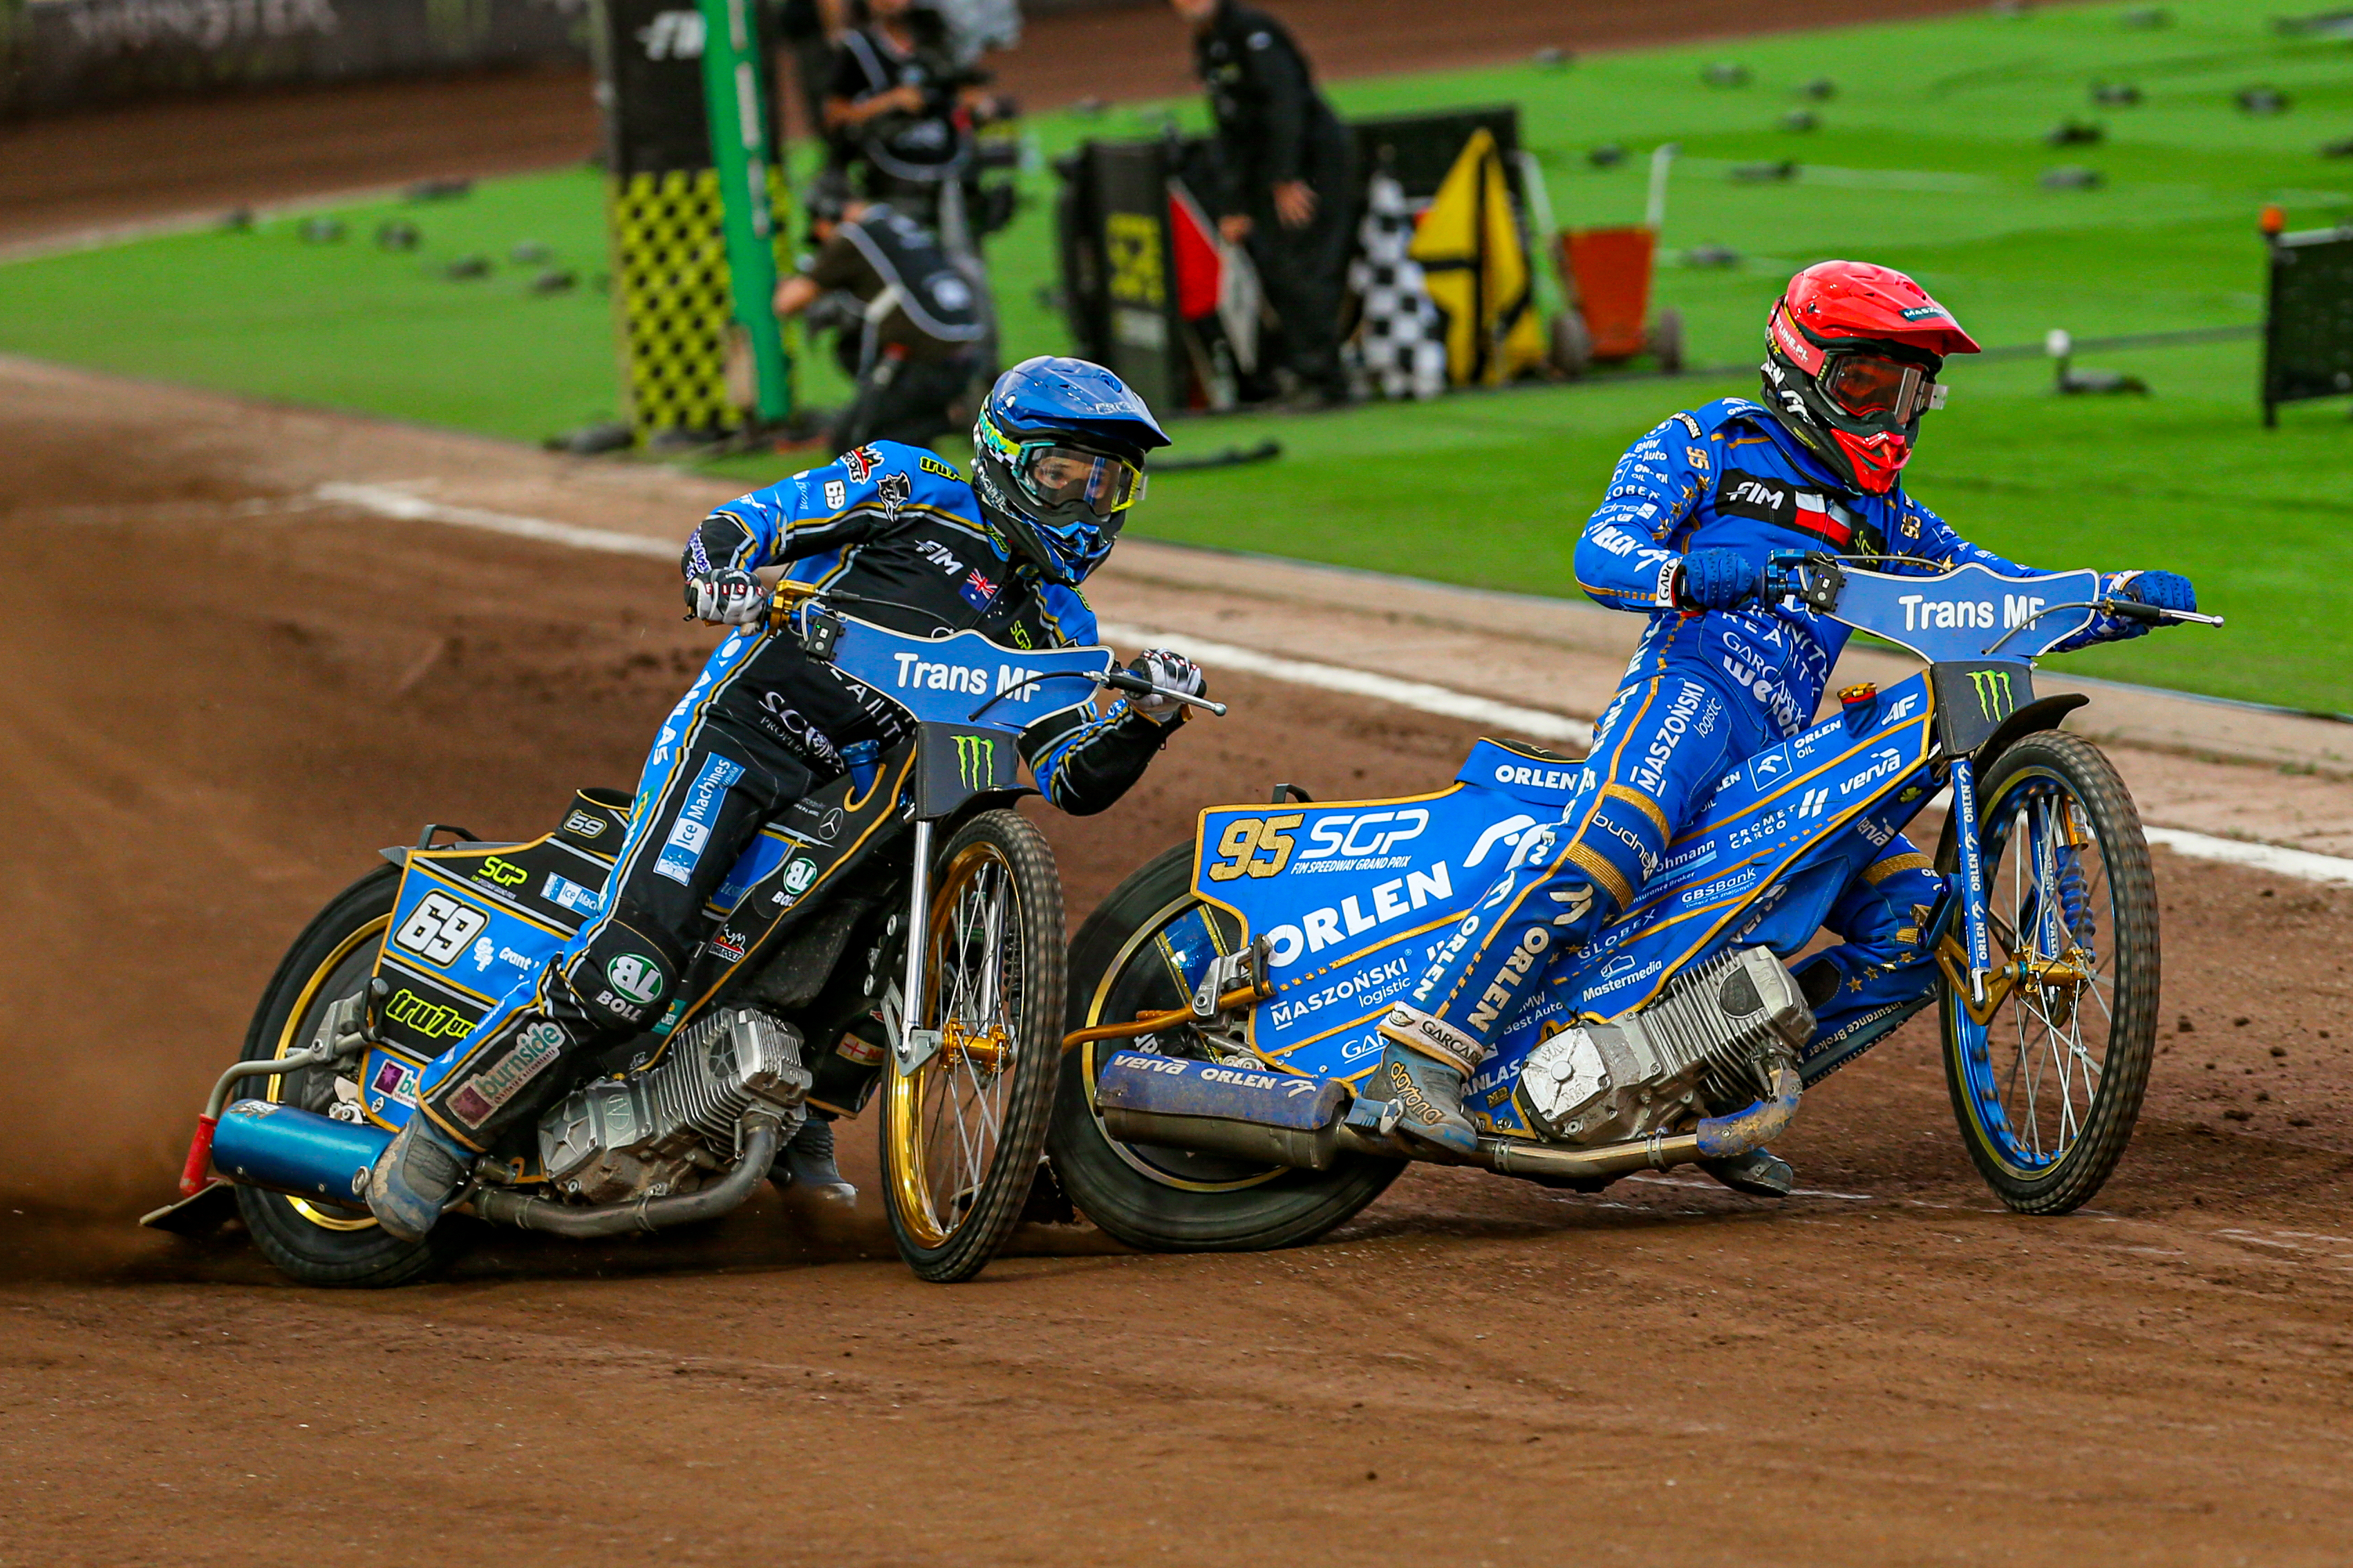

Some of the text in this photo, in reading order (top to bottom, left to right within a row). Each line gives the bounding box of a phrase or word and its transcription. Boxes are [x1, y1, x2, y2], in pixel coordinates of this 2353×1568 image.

[823, 480, 846, 510] 69
[1727, 481, 1784, 510] FIM
[915, 540, 964, 576] FIM
[1898, 594, 2045, 631] Trans MF
[894, 653, 1044, 703] Trans MF
[1693, 697, 1722, 739] logistic
[1794, 720, 1841, 748] ORLEN
[1797, 746, 1816, 759] OIL
[687, 759, 731, 820] Machines
[1494, 764, 1578, 791] ORLEN
[1839, 748, 1900, 796] verva
[1963, 784, 1975, 823] ORLEN
[565, 815, 606, 837] 69
[675, 824, 697, 847] Ice
[1729, 803, 1797, 841] PROMET
[1730, 820, 1787, 849] CARGO
[1208, 809, 1429, 882] 95 SGP
[478, 856, 528, 887] SGP
[1307, 859, 1357, 874] SPEEDWAY
[1356, 857, 1389, 870] GRAND
[1387, 856, 1412, 868] PRIX
[1968, 853, 1981, 892] ORLEN
[562, 886, 576, 900] Ice
[1682, 867, 1756, 903] GBSBank
[395, 889, 489, 968] 69
[1267, 861, 1454, 967] ORLEN
[1413, 915, 1480, 1002] ORLEN
[1975, 922, 1988, 961] ORLEN
[1271, 958, 1409, 1028] MASZOŃSKI
[1358, 976, 1411, 1008] logistic
[1468, 926, 1550, 1034] ORLEN
[1582, 958, 1663, 1002] Mastermedia
[595, 990, 643, 1023] BOLL
[1535, 1002, 1564, 1021] Auto
[1809, 1028, 1848, 1057] Broker
[476, 1026, 560, 1099] burnside
[1114, 1055, 1277, 1090] verva ORLEN
[1390, 1061, 1443, 1126] daytona
